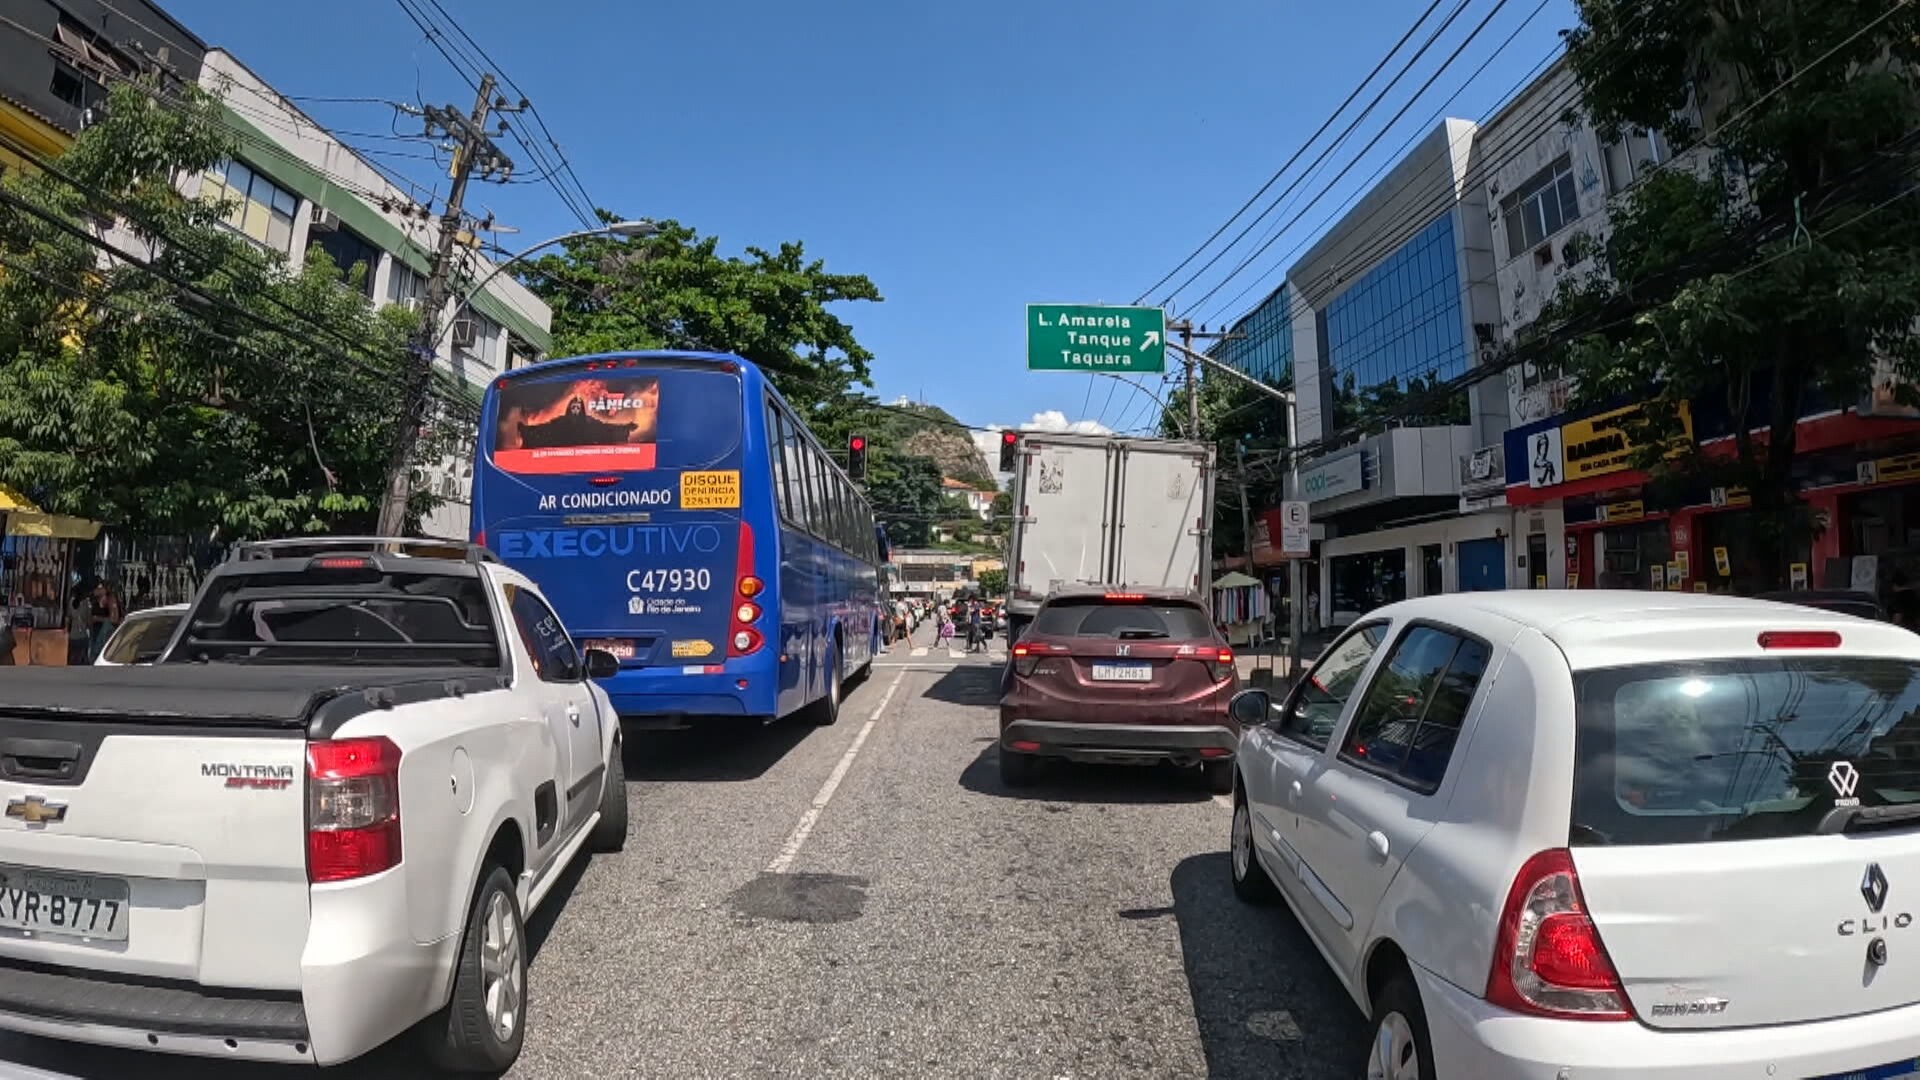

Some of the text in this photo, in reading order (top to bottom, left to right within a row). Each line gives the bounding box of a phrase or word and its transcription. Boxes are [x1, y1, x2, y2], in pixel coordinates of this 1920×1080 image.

[1038, 312, 1131, 329] L. Amarela
[1067, 331, 1131, 348] Tanque
[1061, 350, 1131, 367] Taquara
[587, 397, 644, 411] PÂNICO
[684, 475, 736, 487] DISQUE
[539, 489, 671, 510] AR CONDICIONADO
[1291, 508, 1300, 522] E
[500, 525, 720, 558] EXECUTIVO
[626, 568, 711, 592] C47930
[646, 597, 674, 606] Cidade
[646, 604, 701, 614] Rio de Janeiro
[201, 762, 294, 778] MONTANA
[224, 777, 293, 790] SPORT
[1834, 797, 1860, 807] PROUD
[1837, 912, 1913, 937] CLIO
[1651, 997, 1730, 1016] RENAULT
